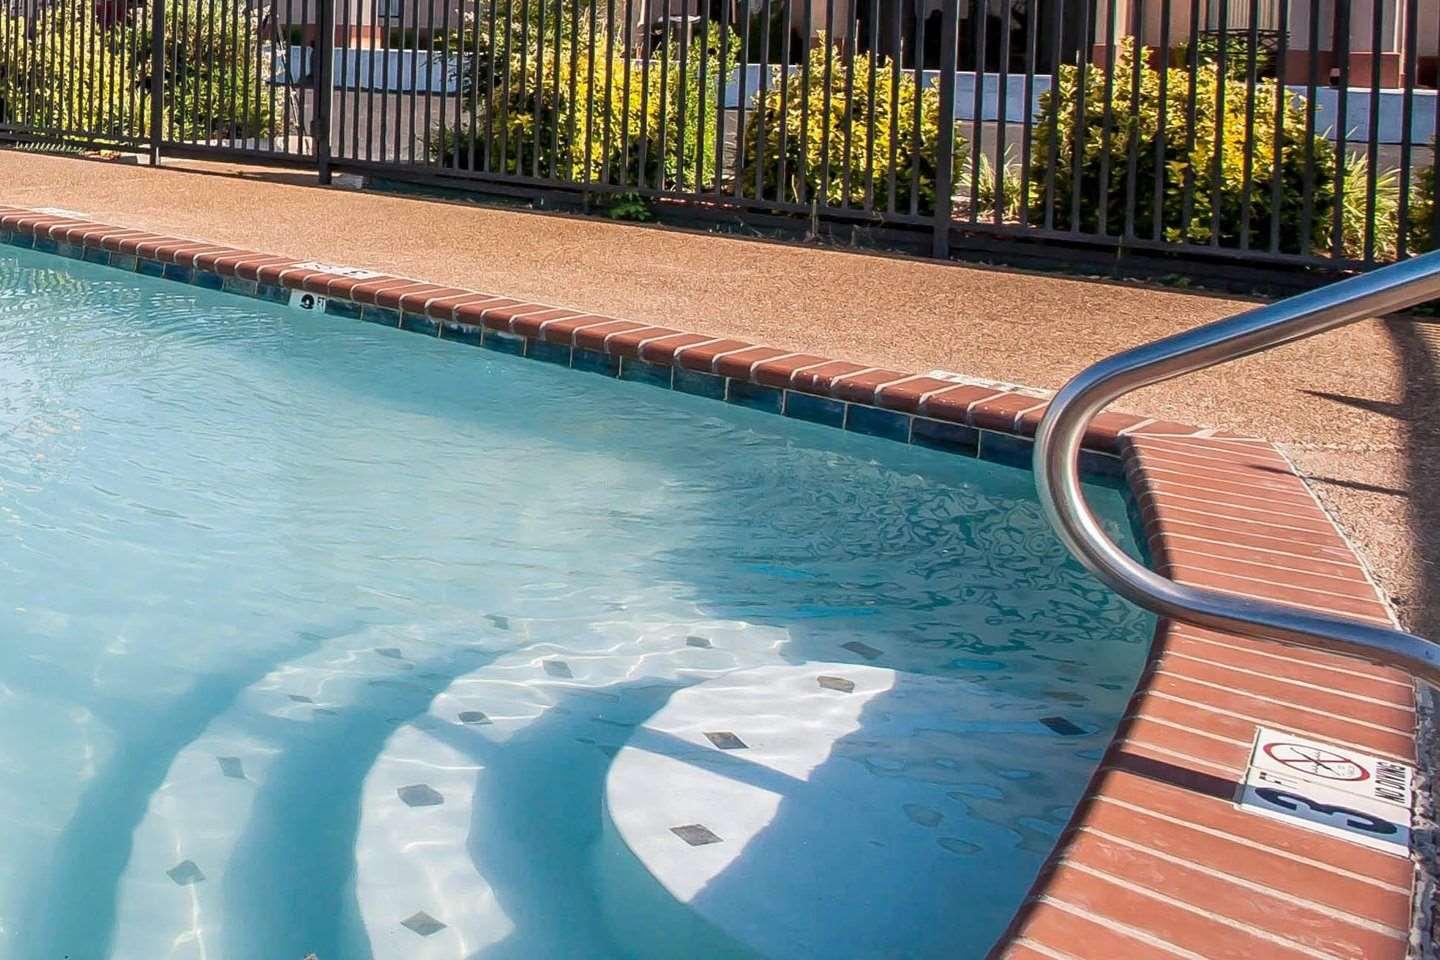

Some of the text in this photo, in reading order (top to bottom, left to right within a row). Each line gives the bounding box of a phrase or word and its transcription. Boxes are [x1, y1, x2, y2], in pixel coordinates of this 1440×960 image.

[1374, 761, 1406, 804] NO DIVING
[1254, 787, 1398, 834] 3
